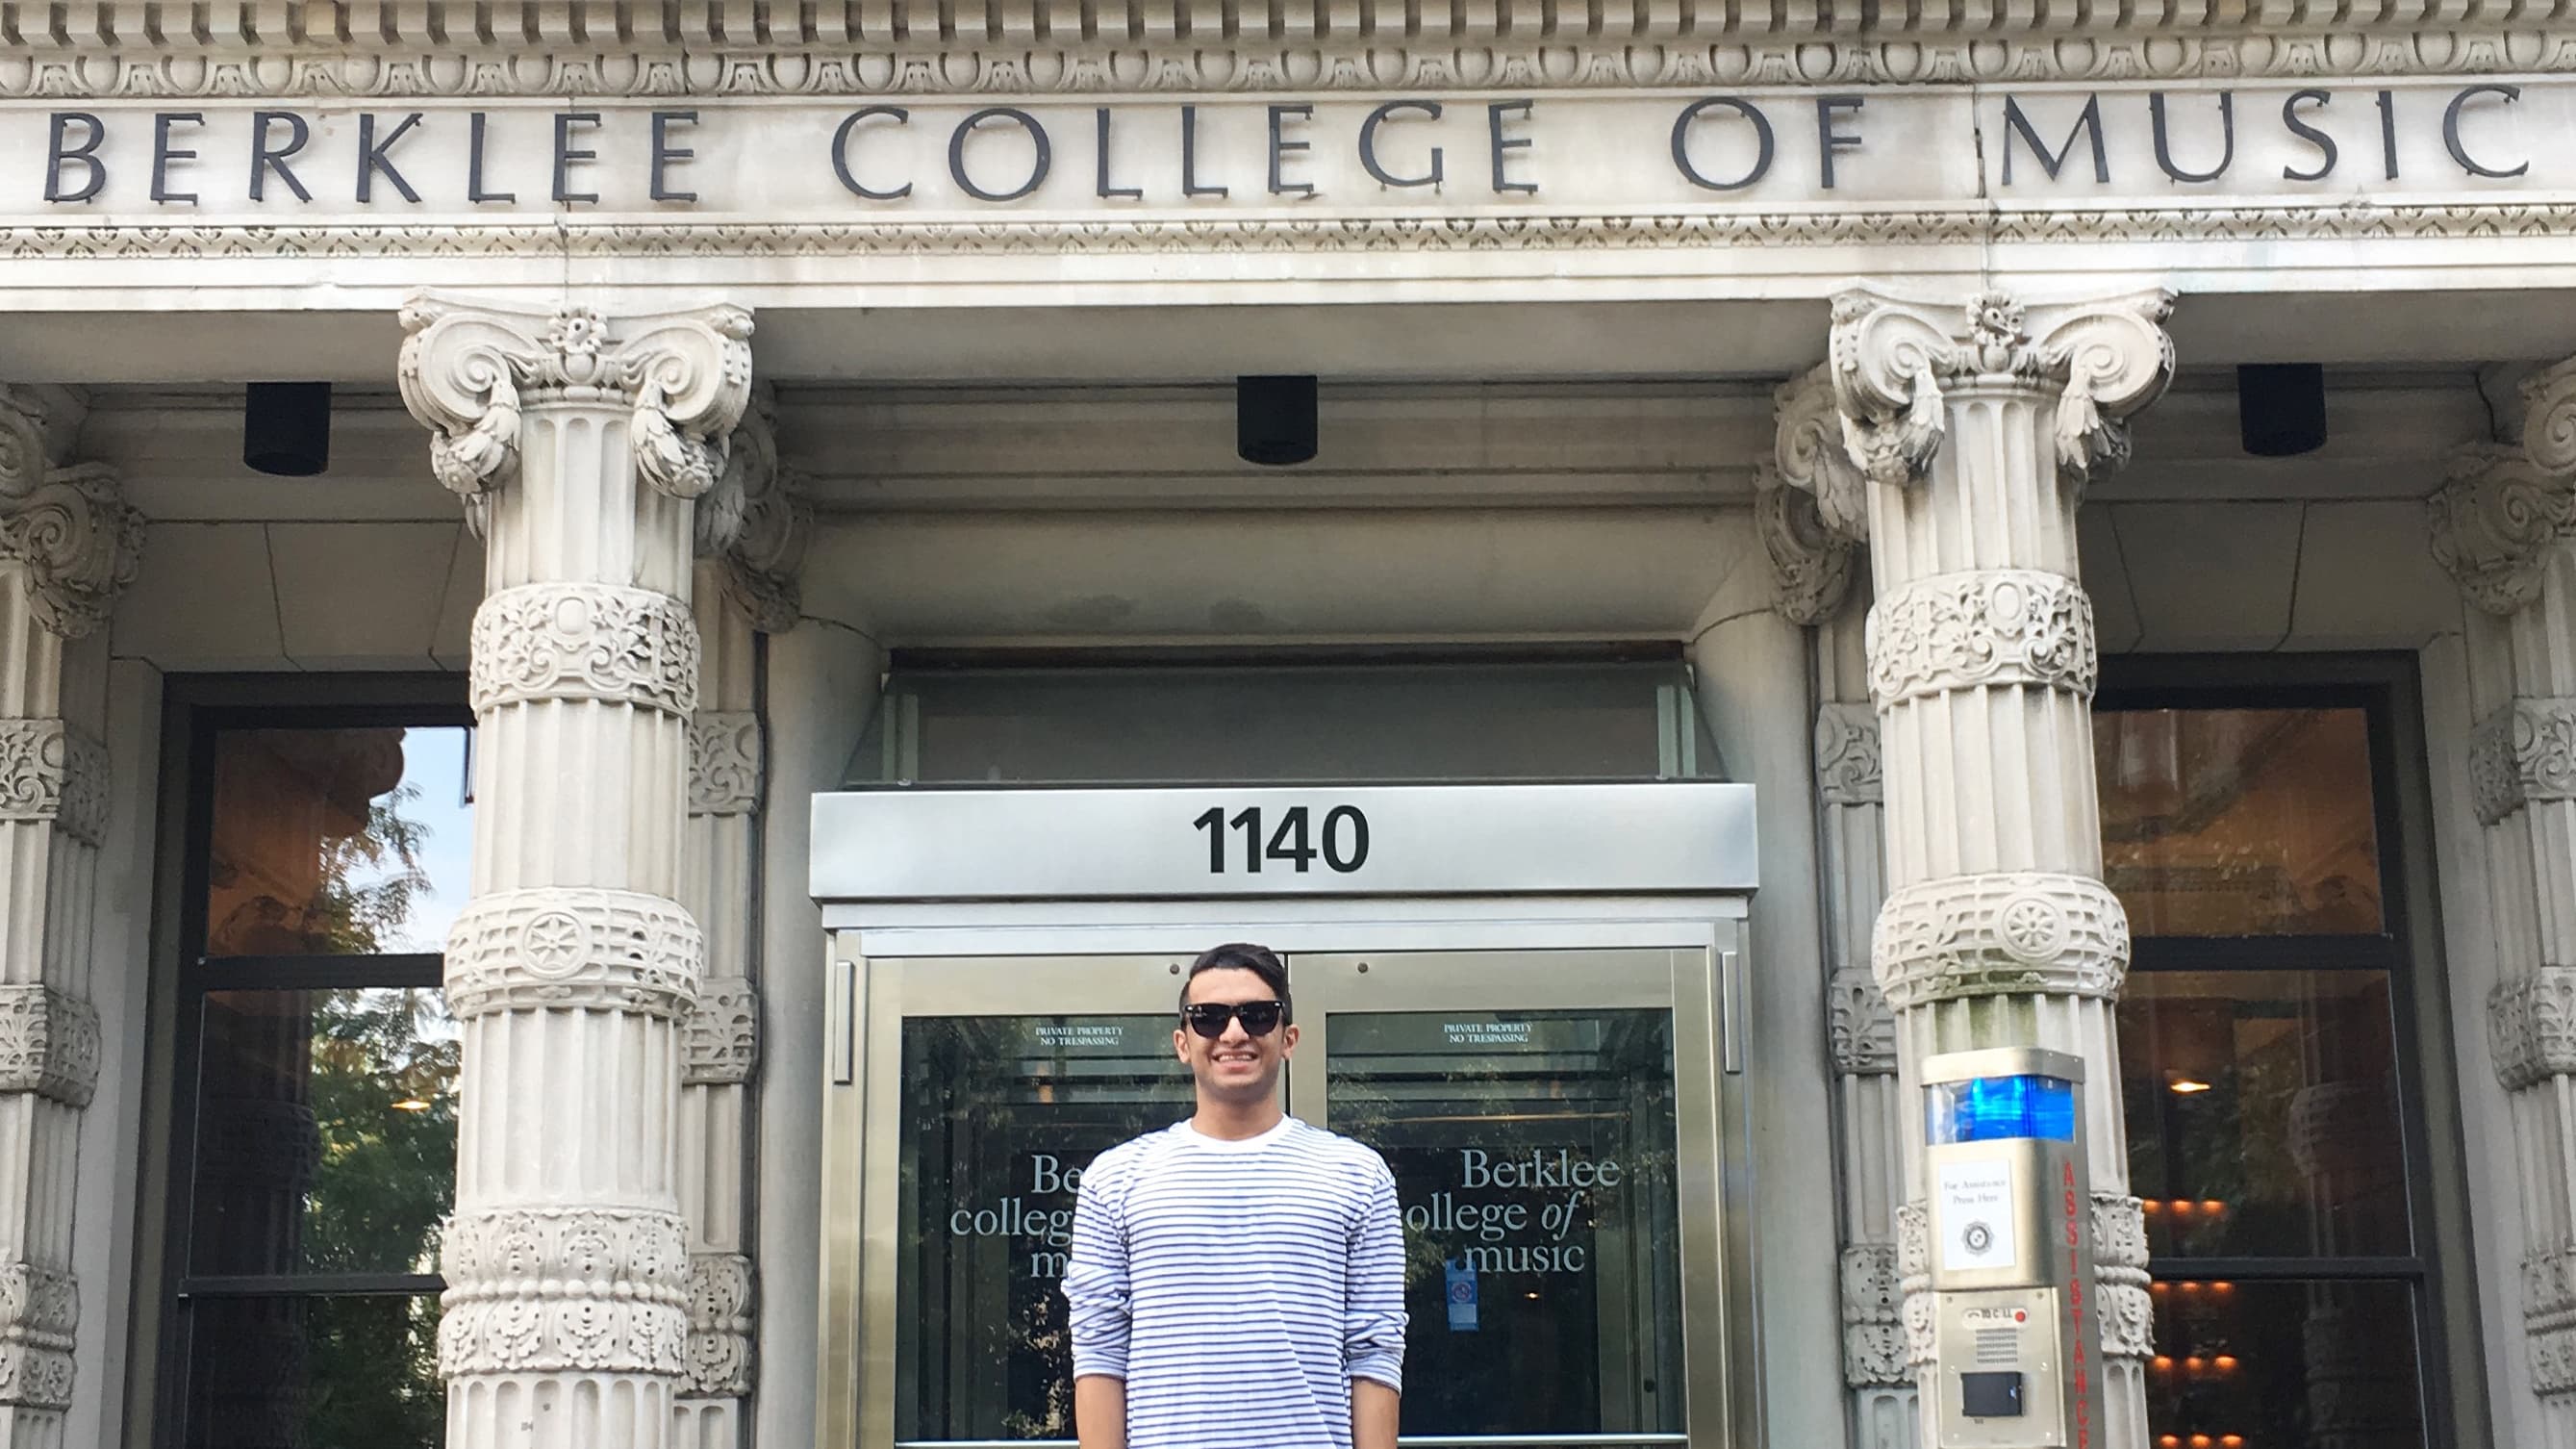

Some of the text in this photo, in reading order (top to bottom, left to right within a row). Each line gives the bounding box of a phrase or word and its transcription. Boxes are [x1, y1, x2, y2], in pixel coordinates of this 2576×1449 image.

[43, 83, 2530, 204] BERKLEE COLLEGE OF MUSIC
[1193, 804, 1370, 874] 1140
[1035, 1026, 1124, 1035] PRIVATE PROPERTY
[1040, 1036, 1120, 1046] NO TRESPASSING
[1444, 1022, 1532, 1032] PRIVATE PROPERTY
[1449, 1033, 1528, 1043] NO TRESPASSING
[1460, 1149, 1621, 1189] Berklee
[950, 1197, 1073, 1247] colleg
[1405, 1190, 1581, 1242] ollege of
[1463, 1245, 1585, 1273] music
